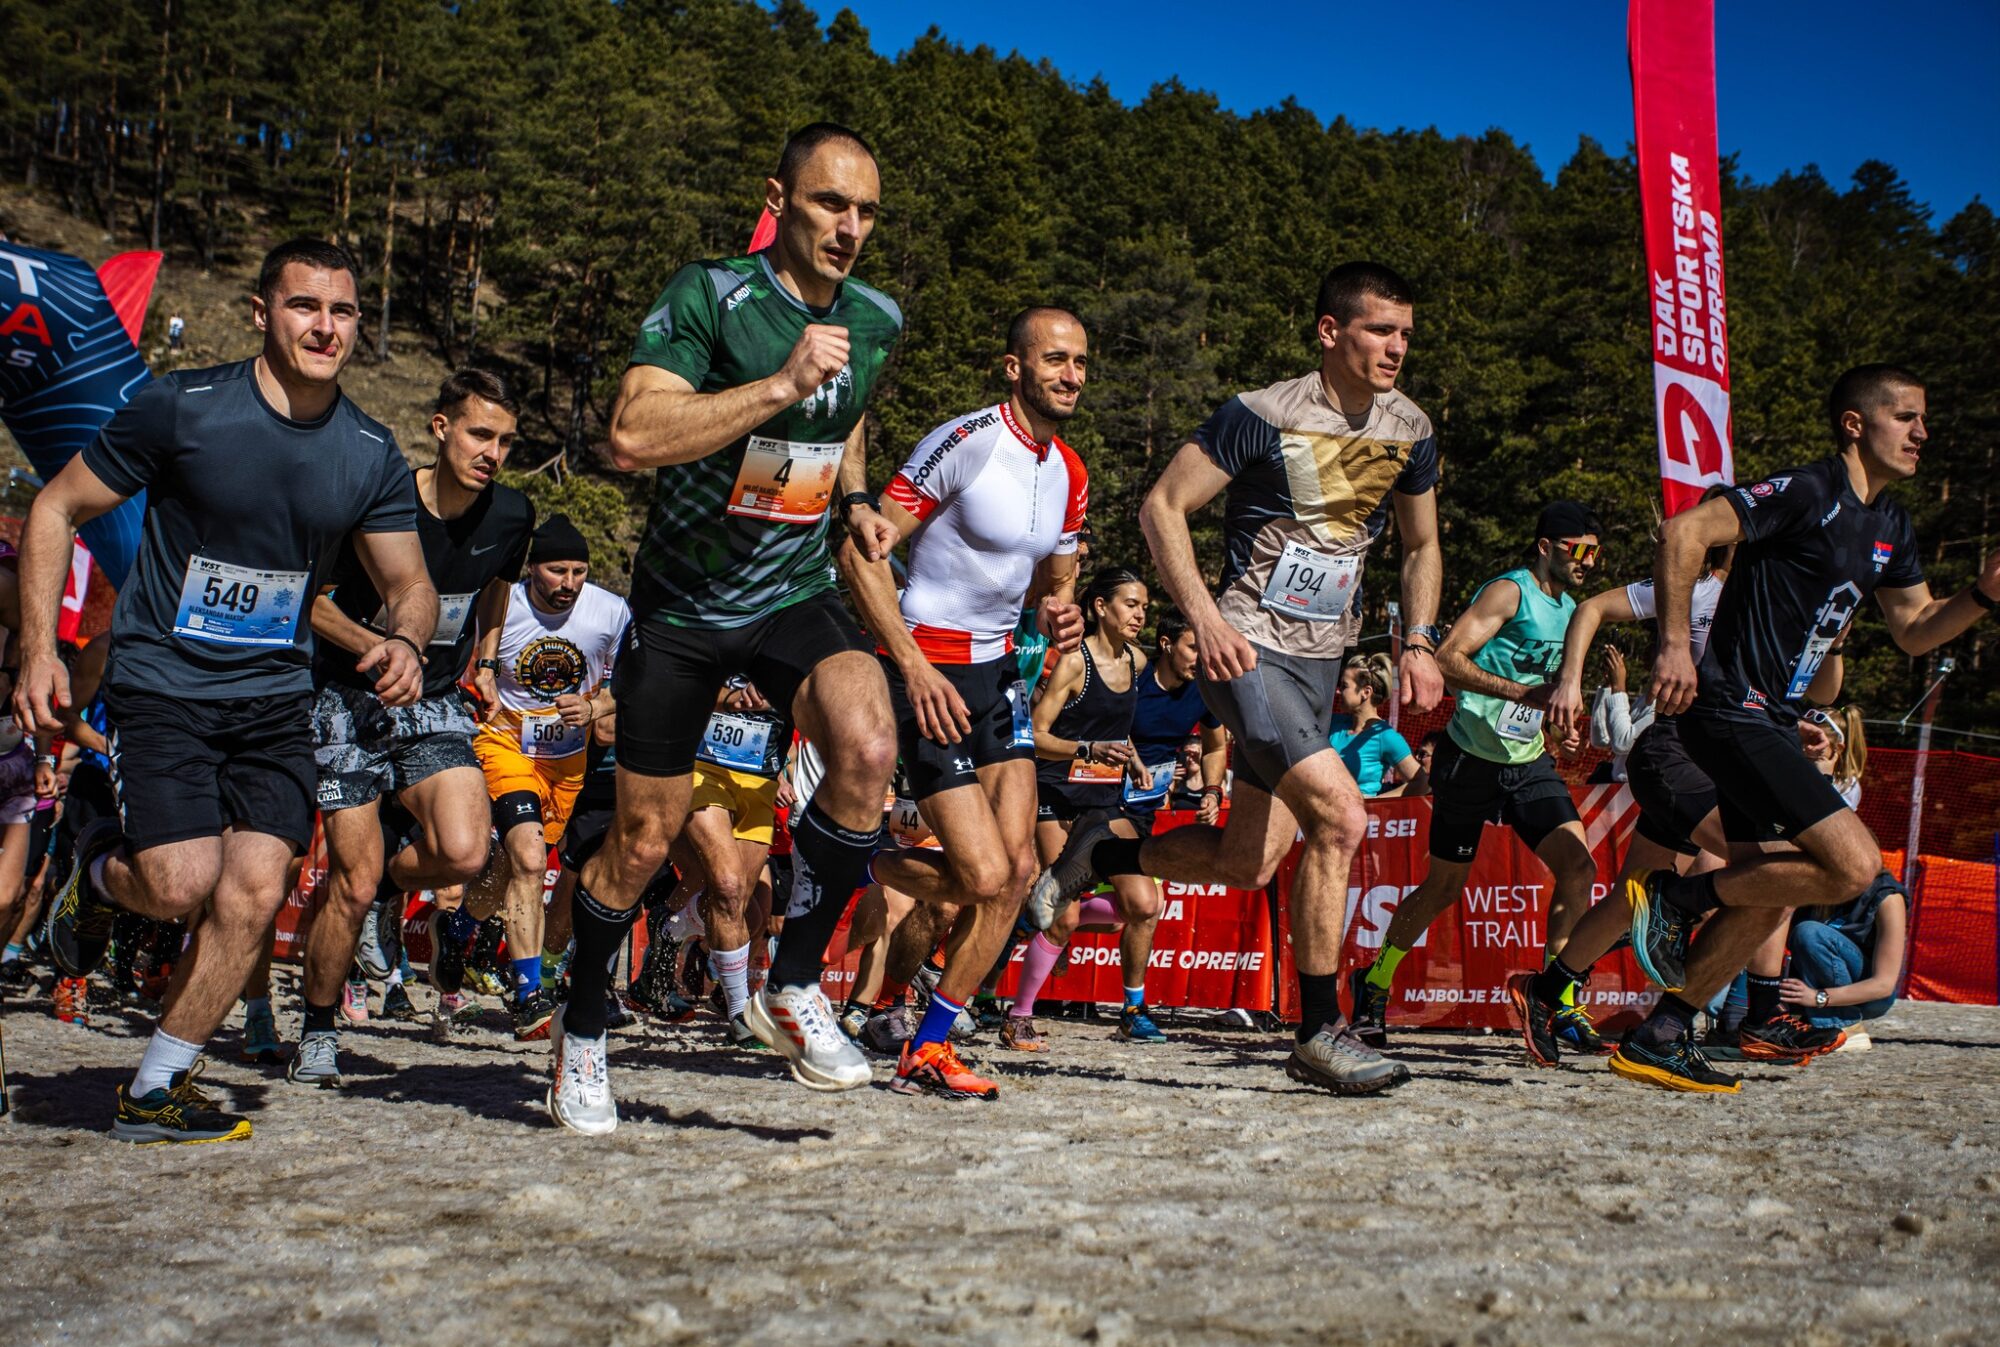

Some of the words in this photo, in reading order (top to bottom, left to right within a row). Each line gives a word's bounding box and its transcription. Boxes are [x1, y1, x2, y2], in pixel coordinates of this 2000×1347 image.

[1670, 152, 1706, 366] SPORTSKA
[1700, 210, 1727, 377] OPREMA
[1654, 269, 1678, 357] DAK
[759, 440, 778, 449] WST
[913, 412, 997, 487] COMPRESSPORT
[774, 458, 794, 488] 4
[1295, 546, 1311, 557] WST
[201, 560, 221, 571] WST
[1285, 563, 1327, 597] 194
[202, 576, 259, 614] 549
[523, 645, 543, 666] BEER
[544, 642, 582, 666] HUNTERS
[1509, 702, 1533, 723] 733
[533, 724, 564, 741] 503
[712, 723, 744, 747] 530
[900, 810, 919, 830] 44
[1384, 819, 1417, 837] SE!
[1464, 884, 1544, 913] WEST
[1178, 950, 1264, 971] OPREME
[1404, 988, 1487, 1004] NAJBOLJE
[1579, 991, 1591, 1005] U
